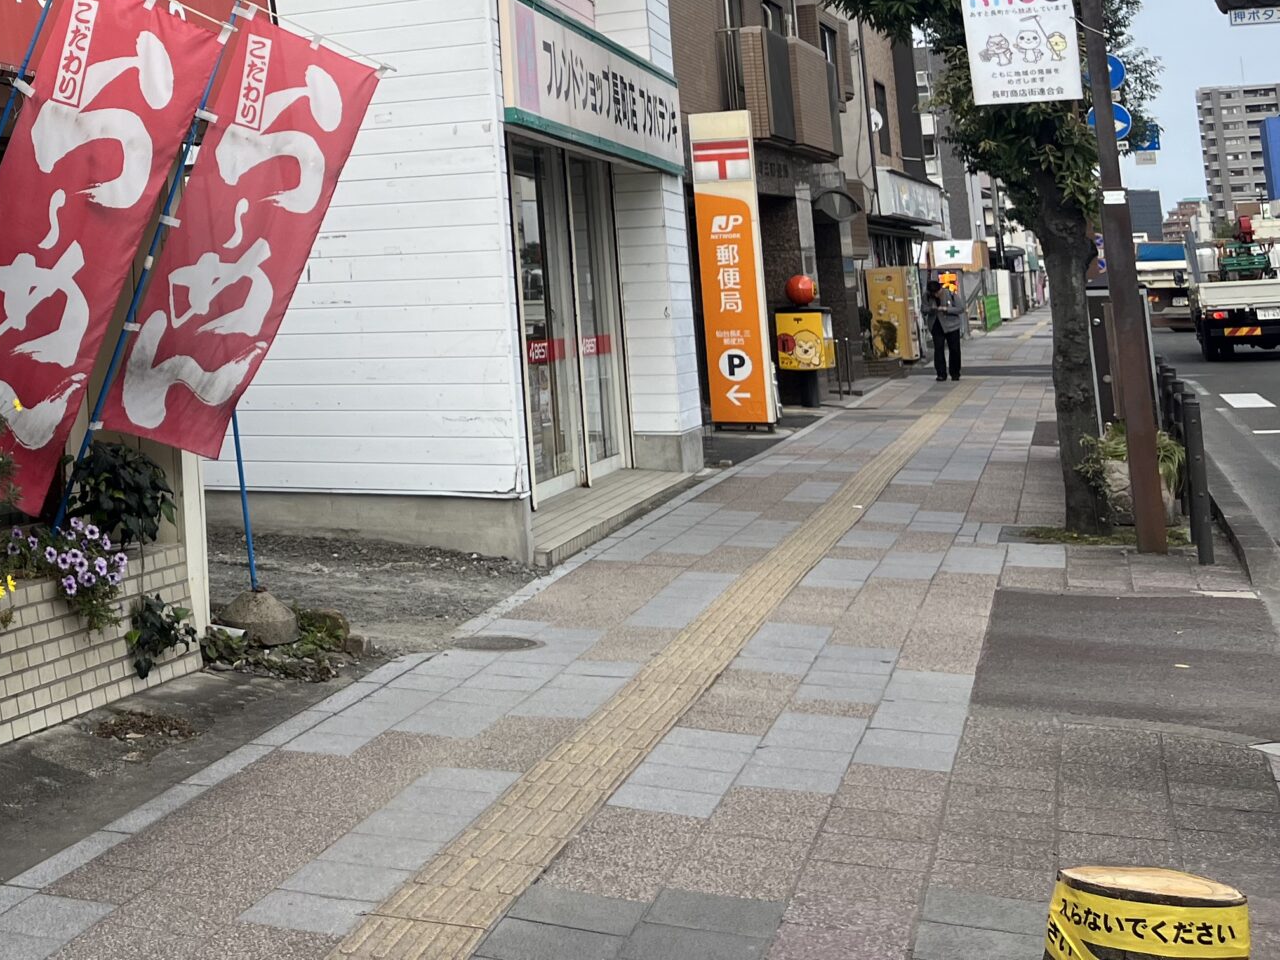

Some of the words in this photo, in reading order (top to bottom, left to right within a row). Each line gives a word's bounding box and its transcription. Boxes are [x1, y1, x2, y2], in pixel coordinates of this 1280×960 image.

[58, 1, 93, 101] こだわり
[241, 39, 266, 124] こだわり
[716, 243, 743, 313] 郵便局
[535, 342, 548, 359] BEST
[727, 354, 746, 376] P
[1059, 898, 1236, 946] 入らないでください
